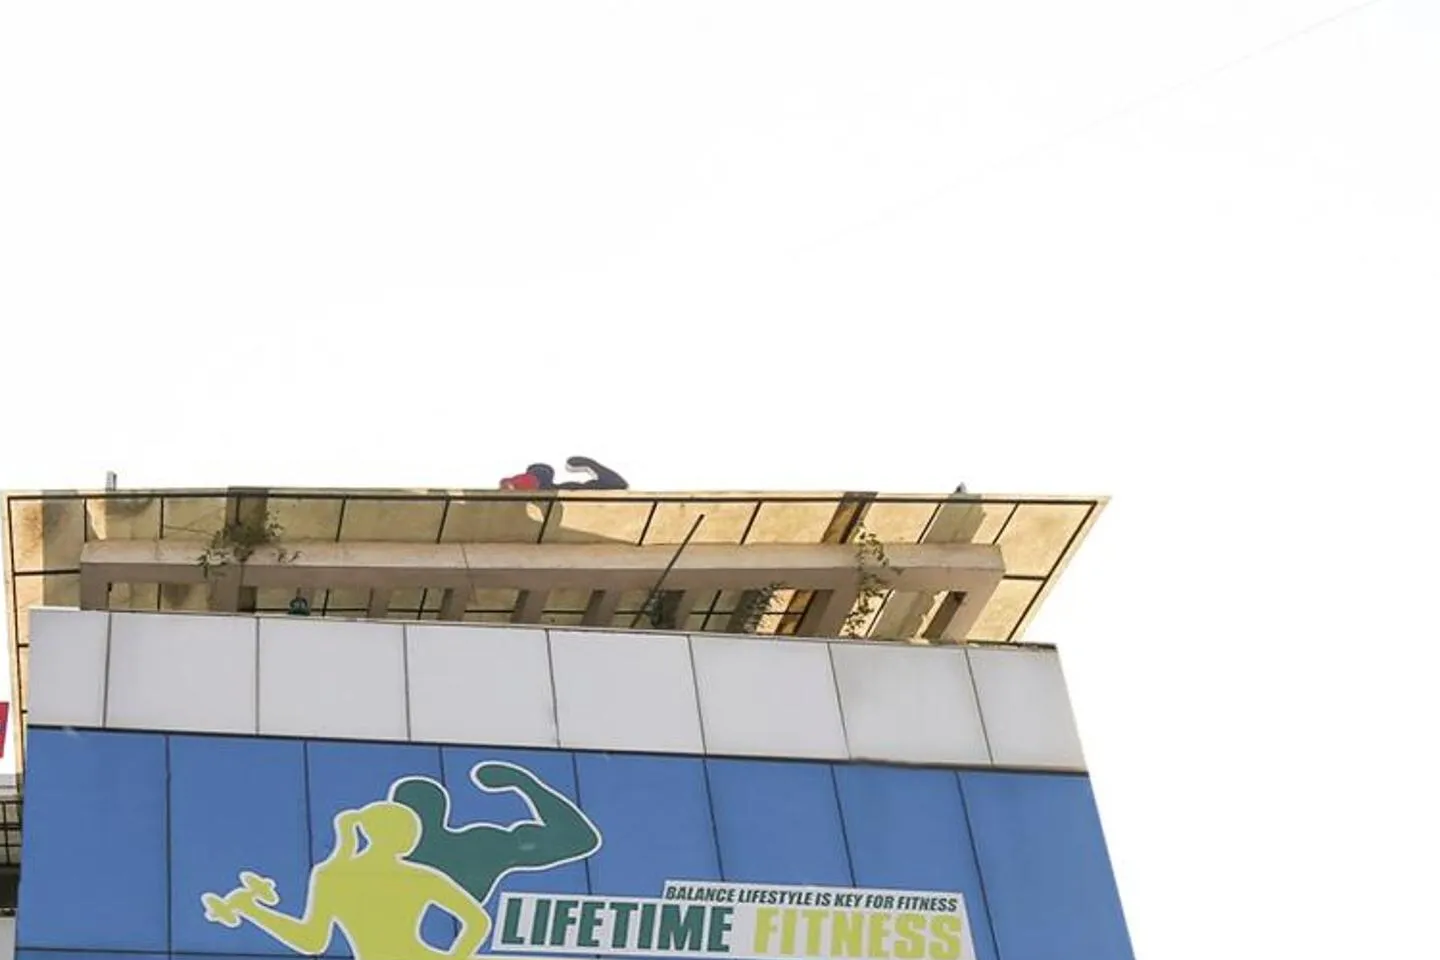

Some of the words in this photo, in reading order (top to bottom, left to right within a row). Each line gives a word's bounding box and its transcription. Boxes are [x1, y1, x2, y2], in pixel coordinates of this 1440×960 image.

[665, 885, 736, 902] BALANCE
[738, 889, 810, 906] LIFESTYLE
[811, 892, 831, 907] IS
[834, 893, 861, 908] KEY
[865, 894, 894, 910] FOR
[897, 896, 958, 912] FITNESS
[501, 898, 734, 952] LIFETIME
[753, 906, 962, 960] FITNESS
